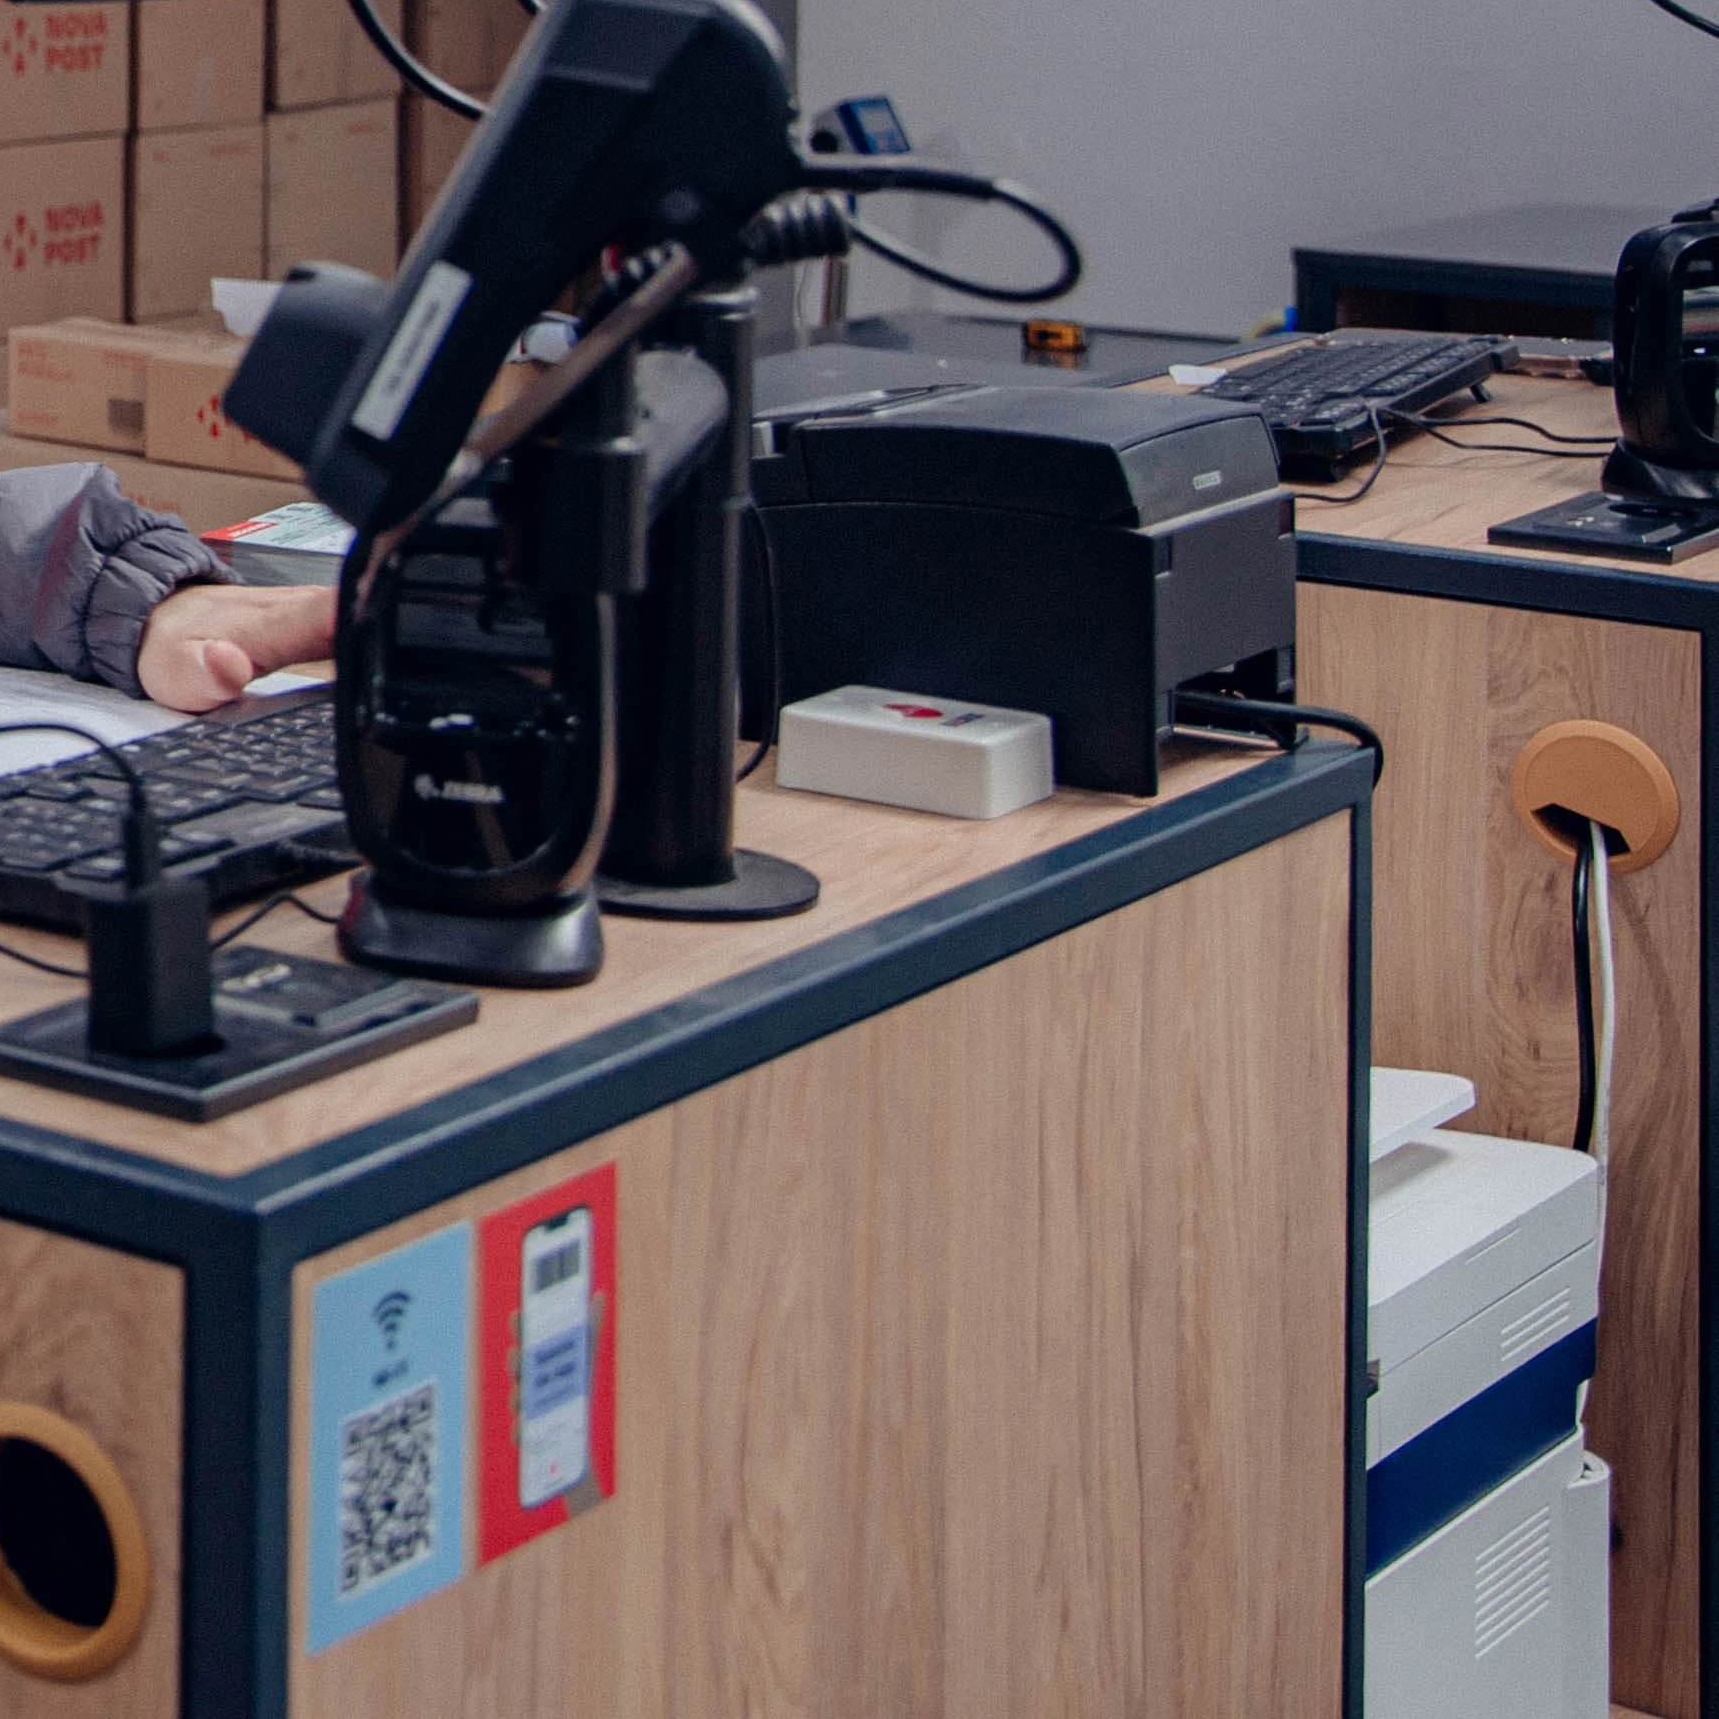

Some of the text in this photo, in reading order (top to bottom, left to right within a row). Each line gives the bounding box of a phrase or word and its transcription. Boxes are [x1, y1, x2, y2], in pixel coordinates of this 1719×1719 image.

[45, 12, 108, 39] NOVA
[45, 43, 105, 74] POST
[45, 199, 105, 233] NOVA
[43, 232, 102, 268] POST
[440, 779, 505, 804] ZEBRA
